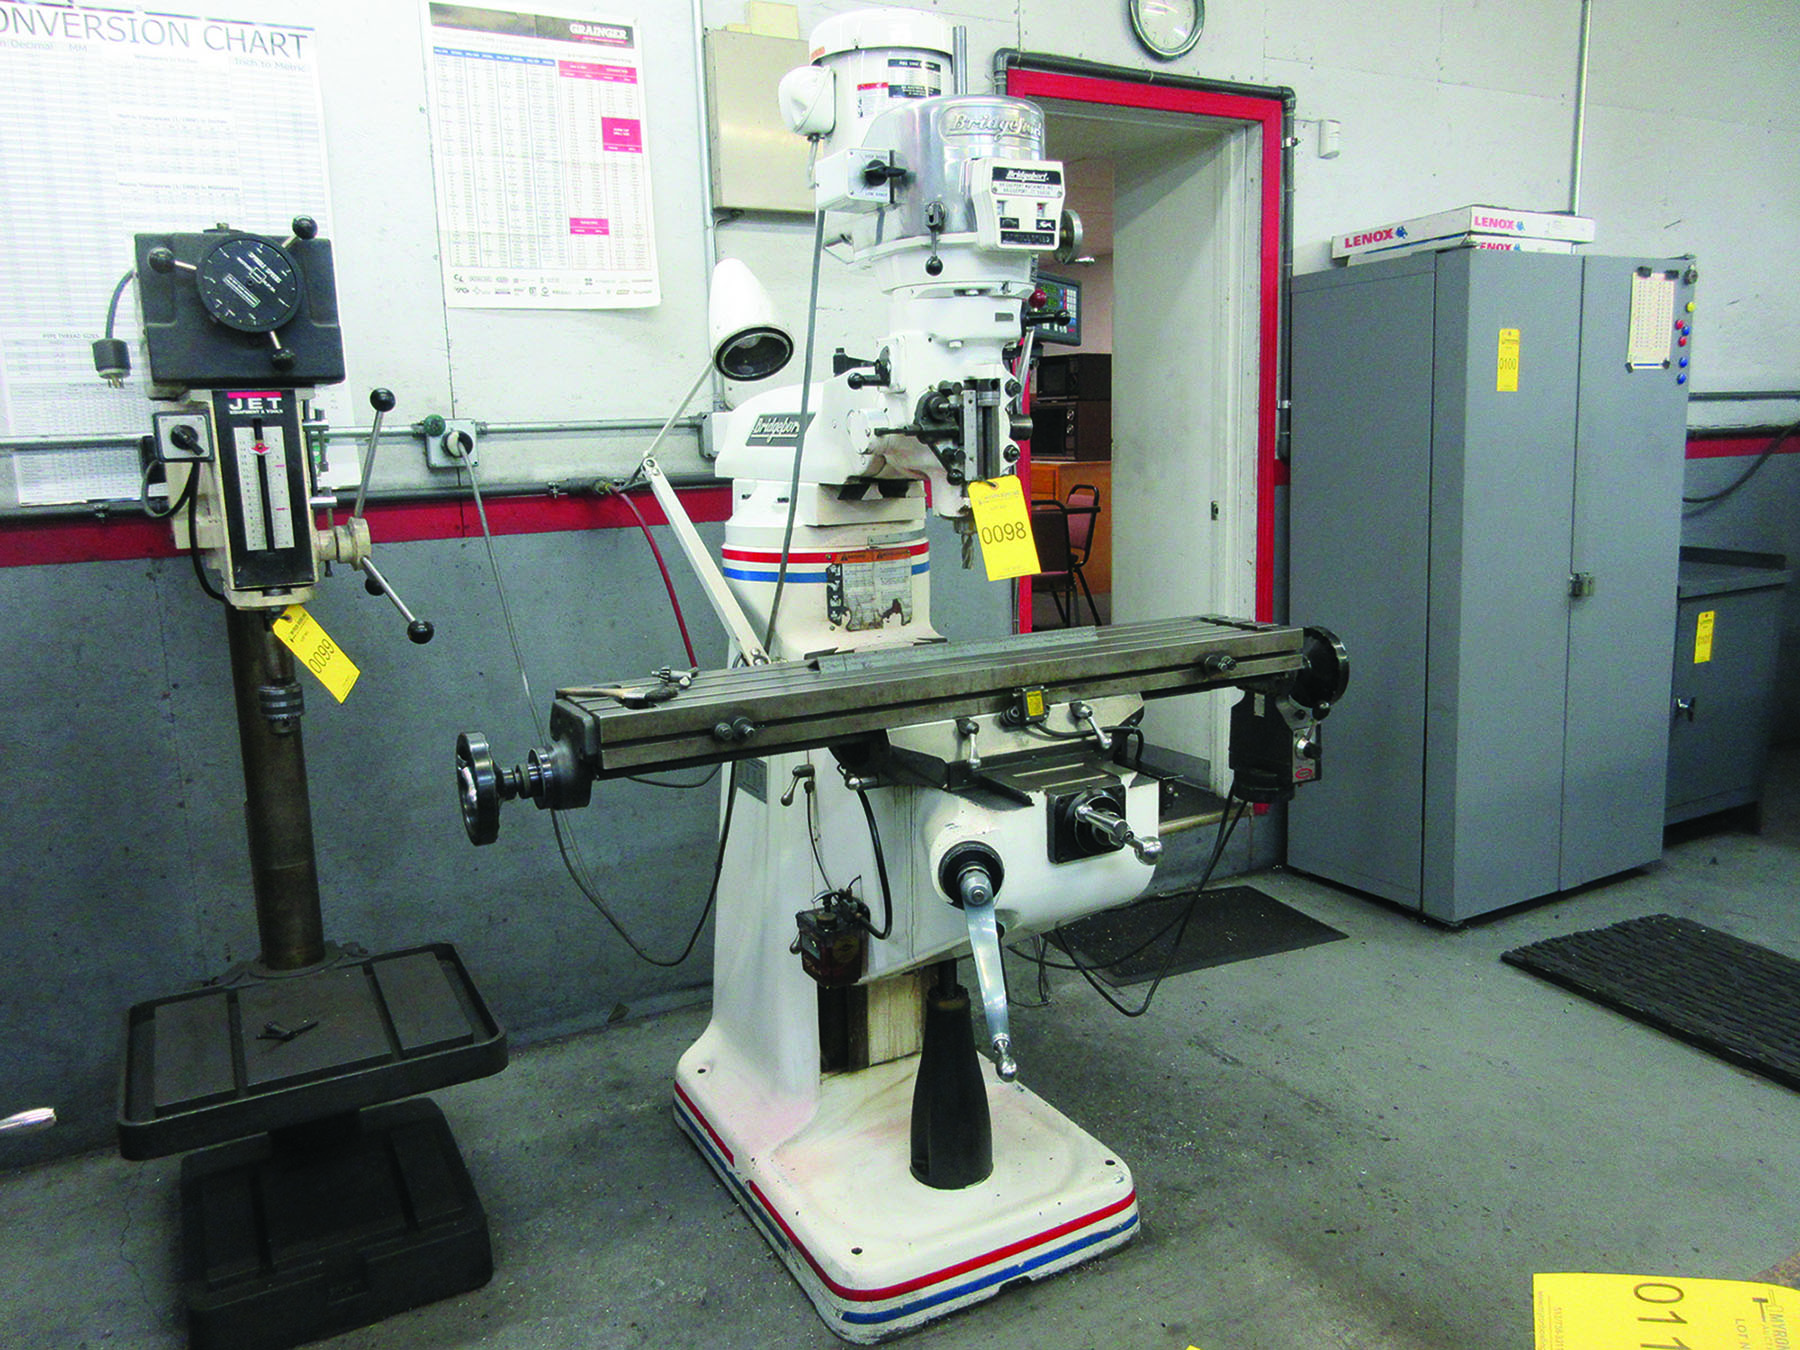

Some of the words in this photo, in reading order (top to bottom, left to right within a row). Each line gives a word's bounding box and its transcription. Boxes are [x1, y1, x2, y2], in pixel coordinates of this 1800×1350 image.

[569, 23, 628, 40] GRAINGER
[203, 25, 308, 59] CHART
[1474, 215, 1514, 230] LENOX
[1344, 227, 1394, 249] LENOX
[1480, 242, 1513, 251] ENOX
[229, 398, 282, 411] JET
[981, 521, 1027, 545] 0098
[308, 638, 335, 674] 0099
[1735, 1318, 1749, 1338] LOT
